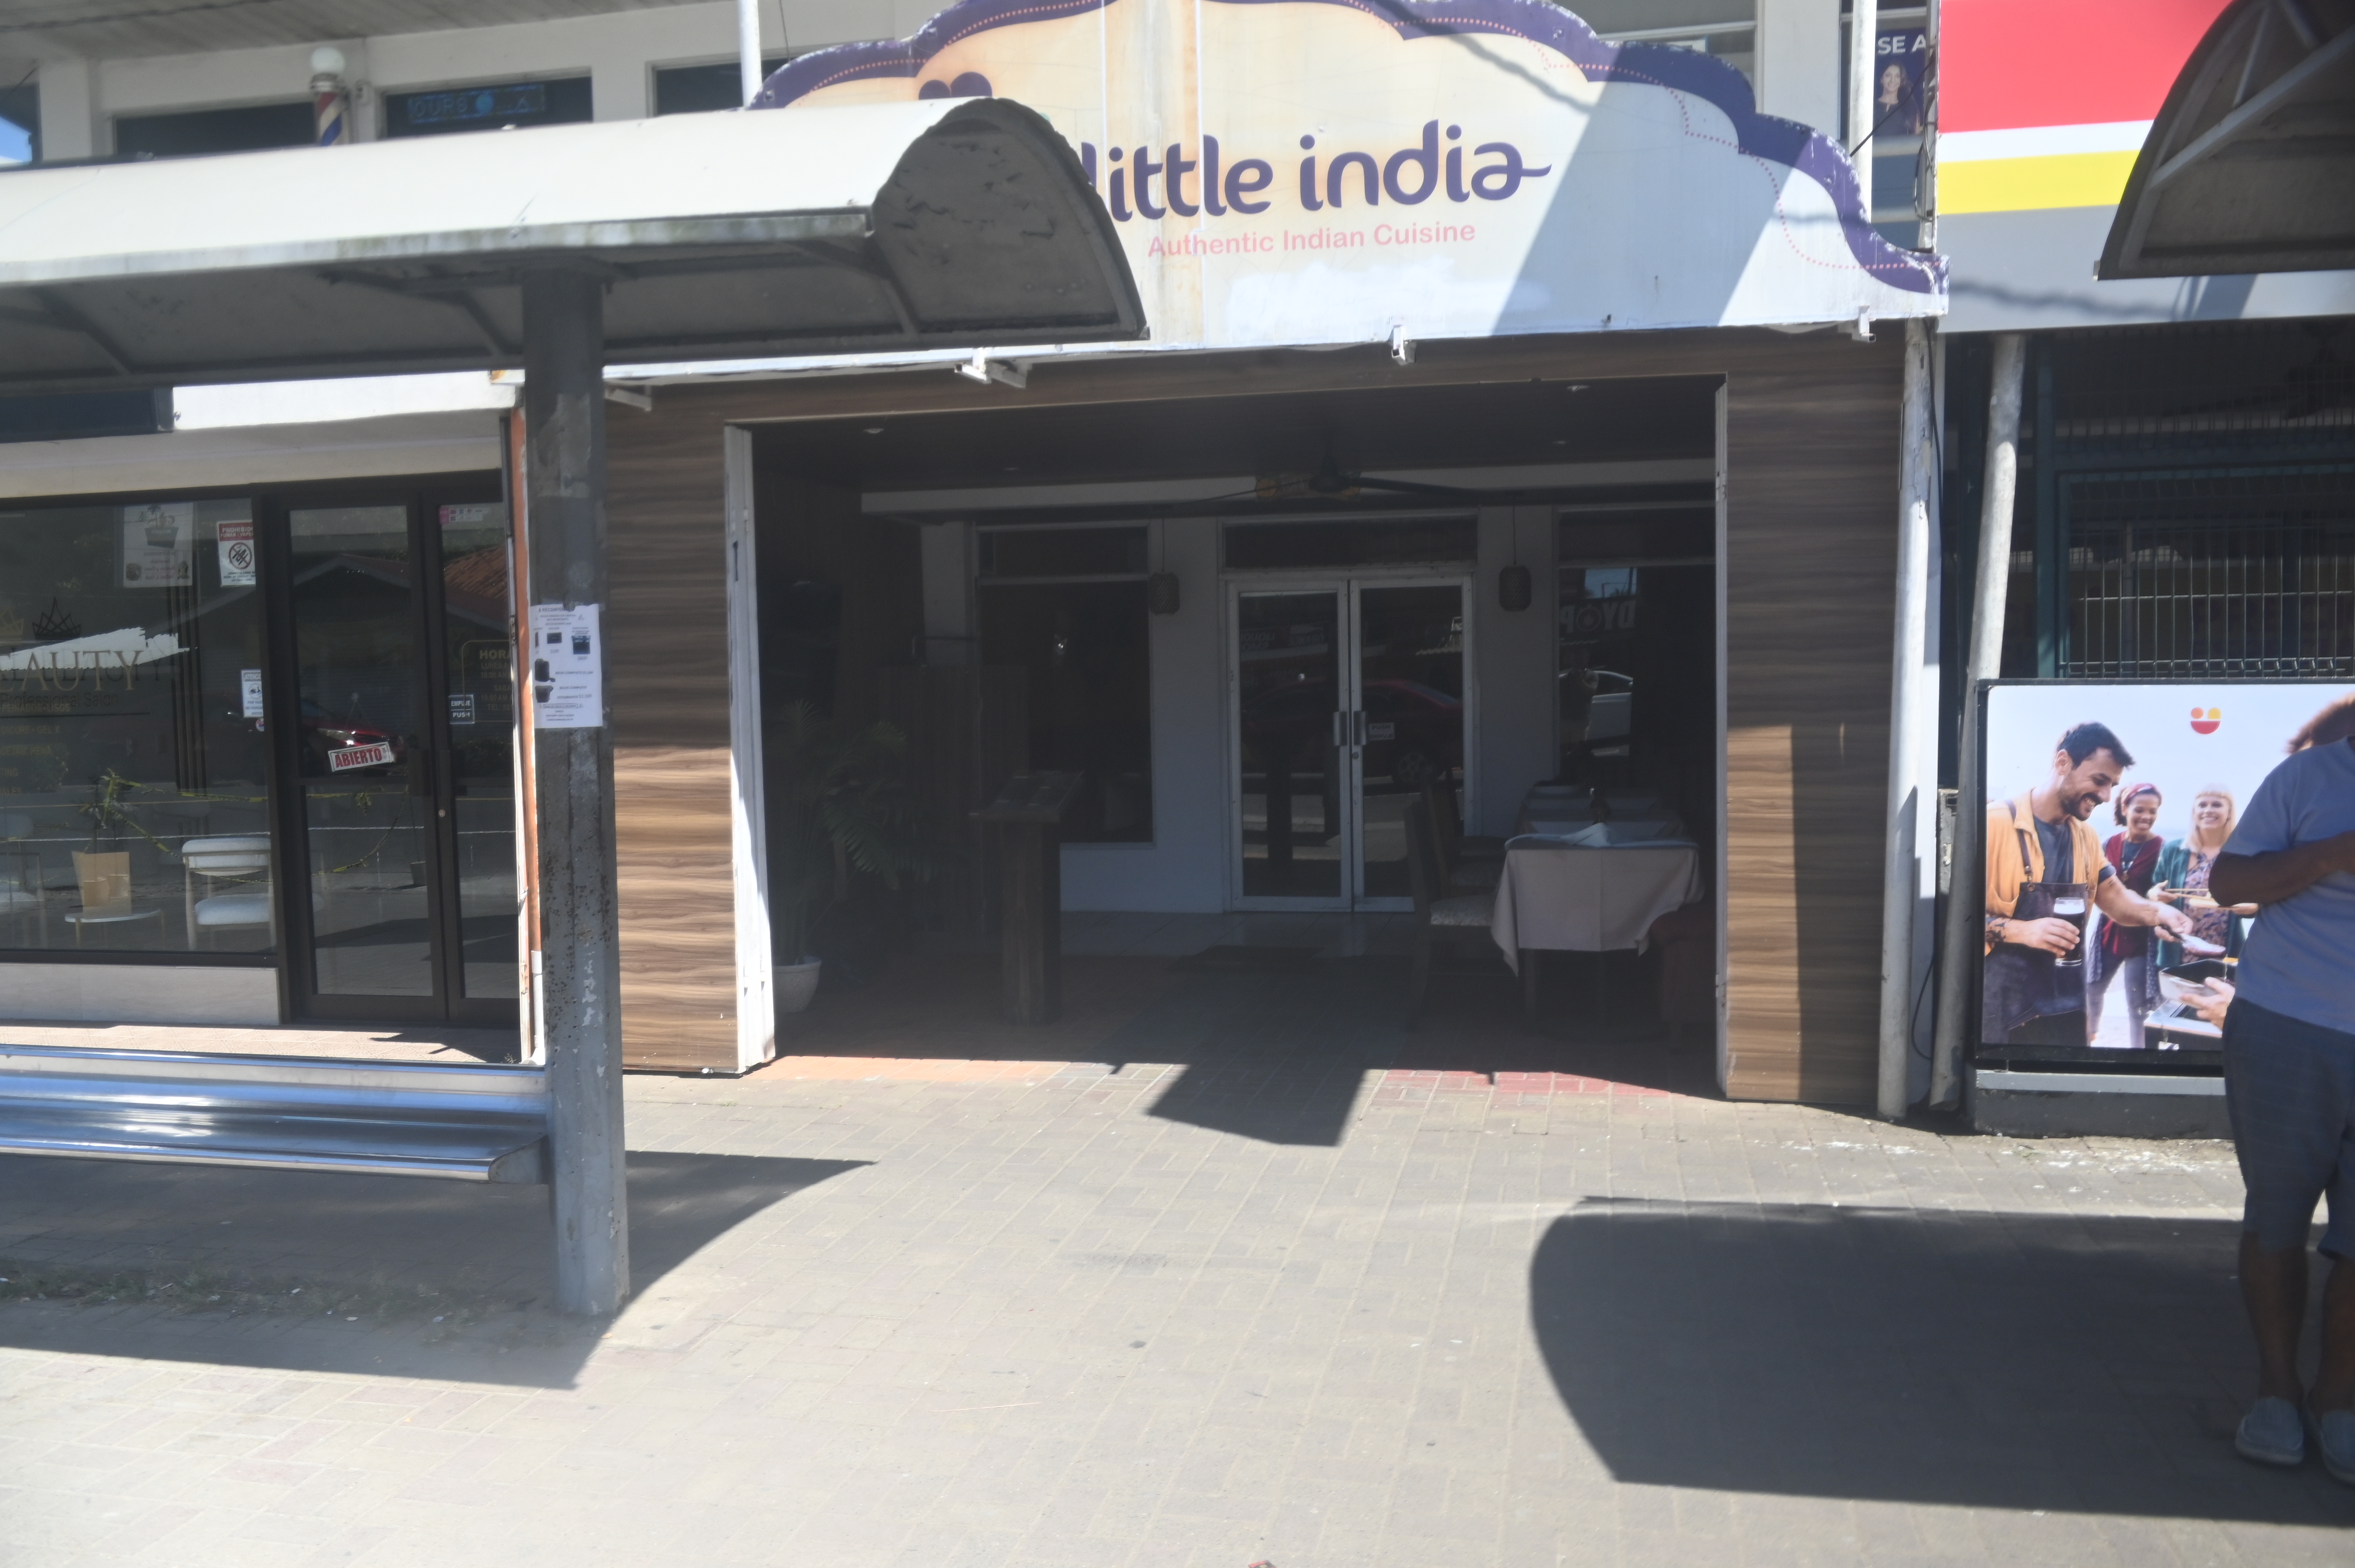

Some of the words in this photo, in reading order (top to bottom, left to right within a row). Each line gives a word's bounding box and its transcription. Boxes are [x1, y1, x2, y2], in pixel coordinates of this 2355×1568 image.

[1877, 35, 1906, 55] SE
[1081, 134, 1274, 223] little
[1299, 119, 1552, 212] india
[1147, 231, 1275, 258] Authentic
[1283, 227, 1365, 252] Indian
[1373, 223, 1477, 247] Cuisine
[335, 747, 383, 768] ABIERTO
